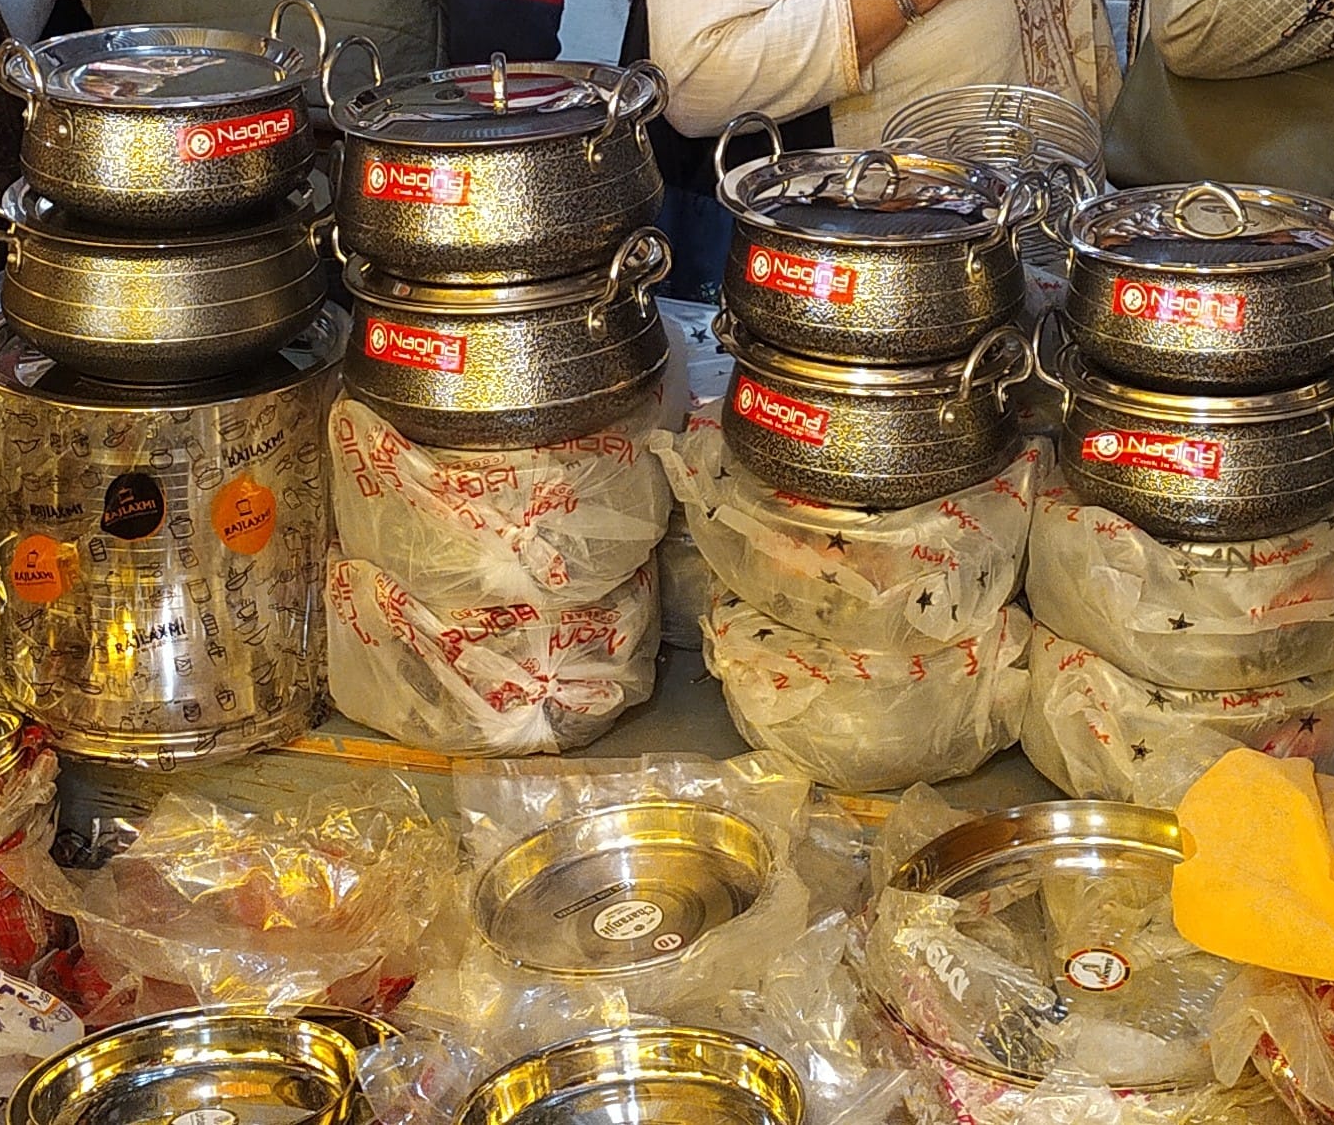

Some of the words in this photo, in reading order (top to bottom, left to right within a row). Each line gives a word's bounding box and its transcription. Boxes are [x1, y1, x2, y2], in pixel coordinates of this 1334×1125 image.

[216, 116, 288, 144] Nagina
[389, 166, 464, 190] Nagina
[773, 258, 850, 287] Nagina
[1150, 290, 1239, 319] Nagina
[389, 332, 460, 356] Nagina
[754, 391, 822, 432] Nagina
[228, 429, 285, 468] RAJLAXMI
[1127, 435, 1217, 465] Nagina
[104, 499, 158, 523] RAJLAXMI
[223, 511, 272, 537] RAJLAXMI
[14, 569, 54, 582] RAJLAXMI
[114, 616, 187, 655] RAJLAXMI
[598, 904, 660, 940] Charanjit
[656, 935, 680, 949] 10
